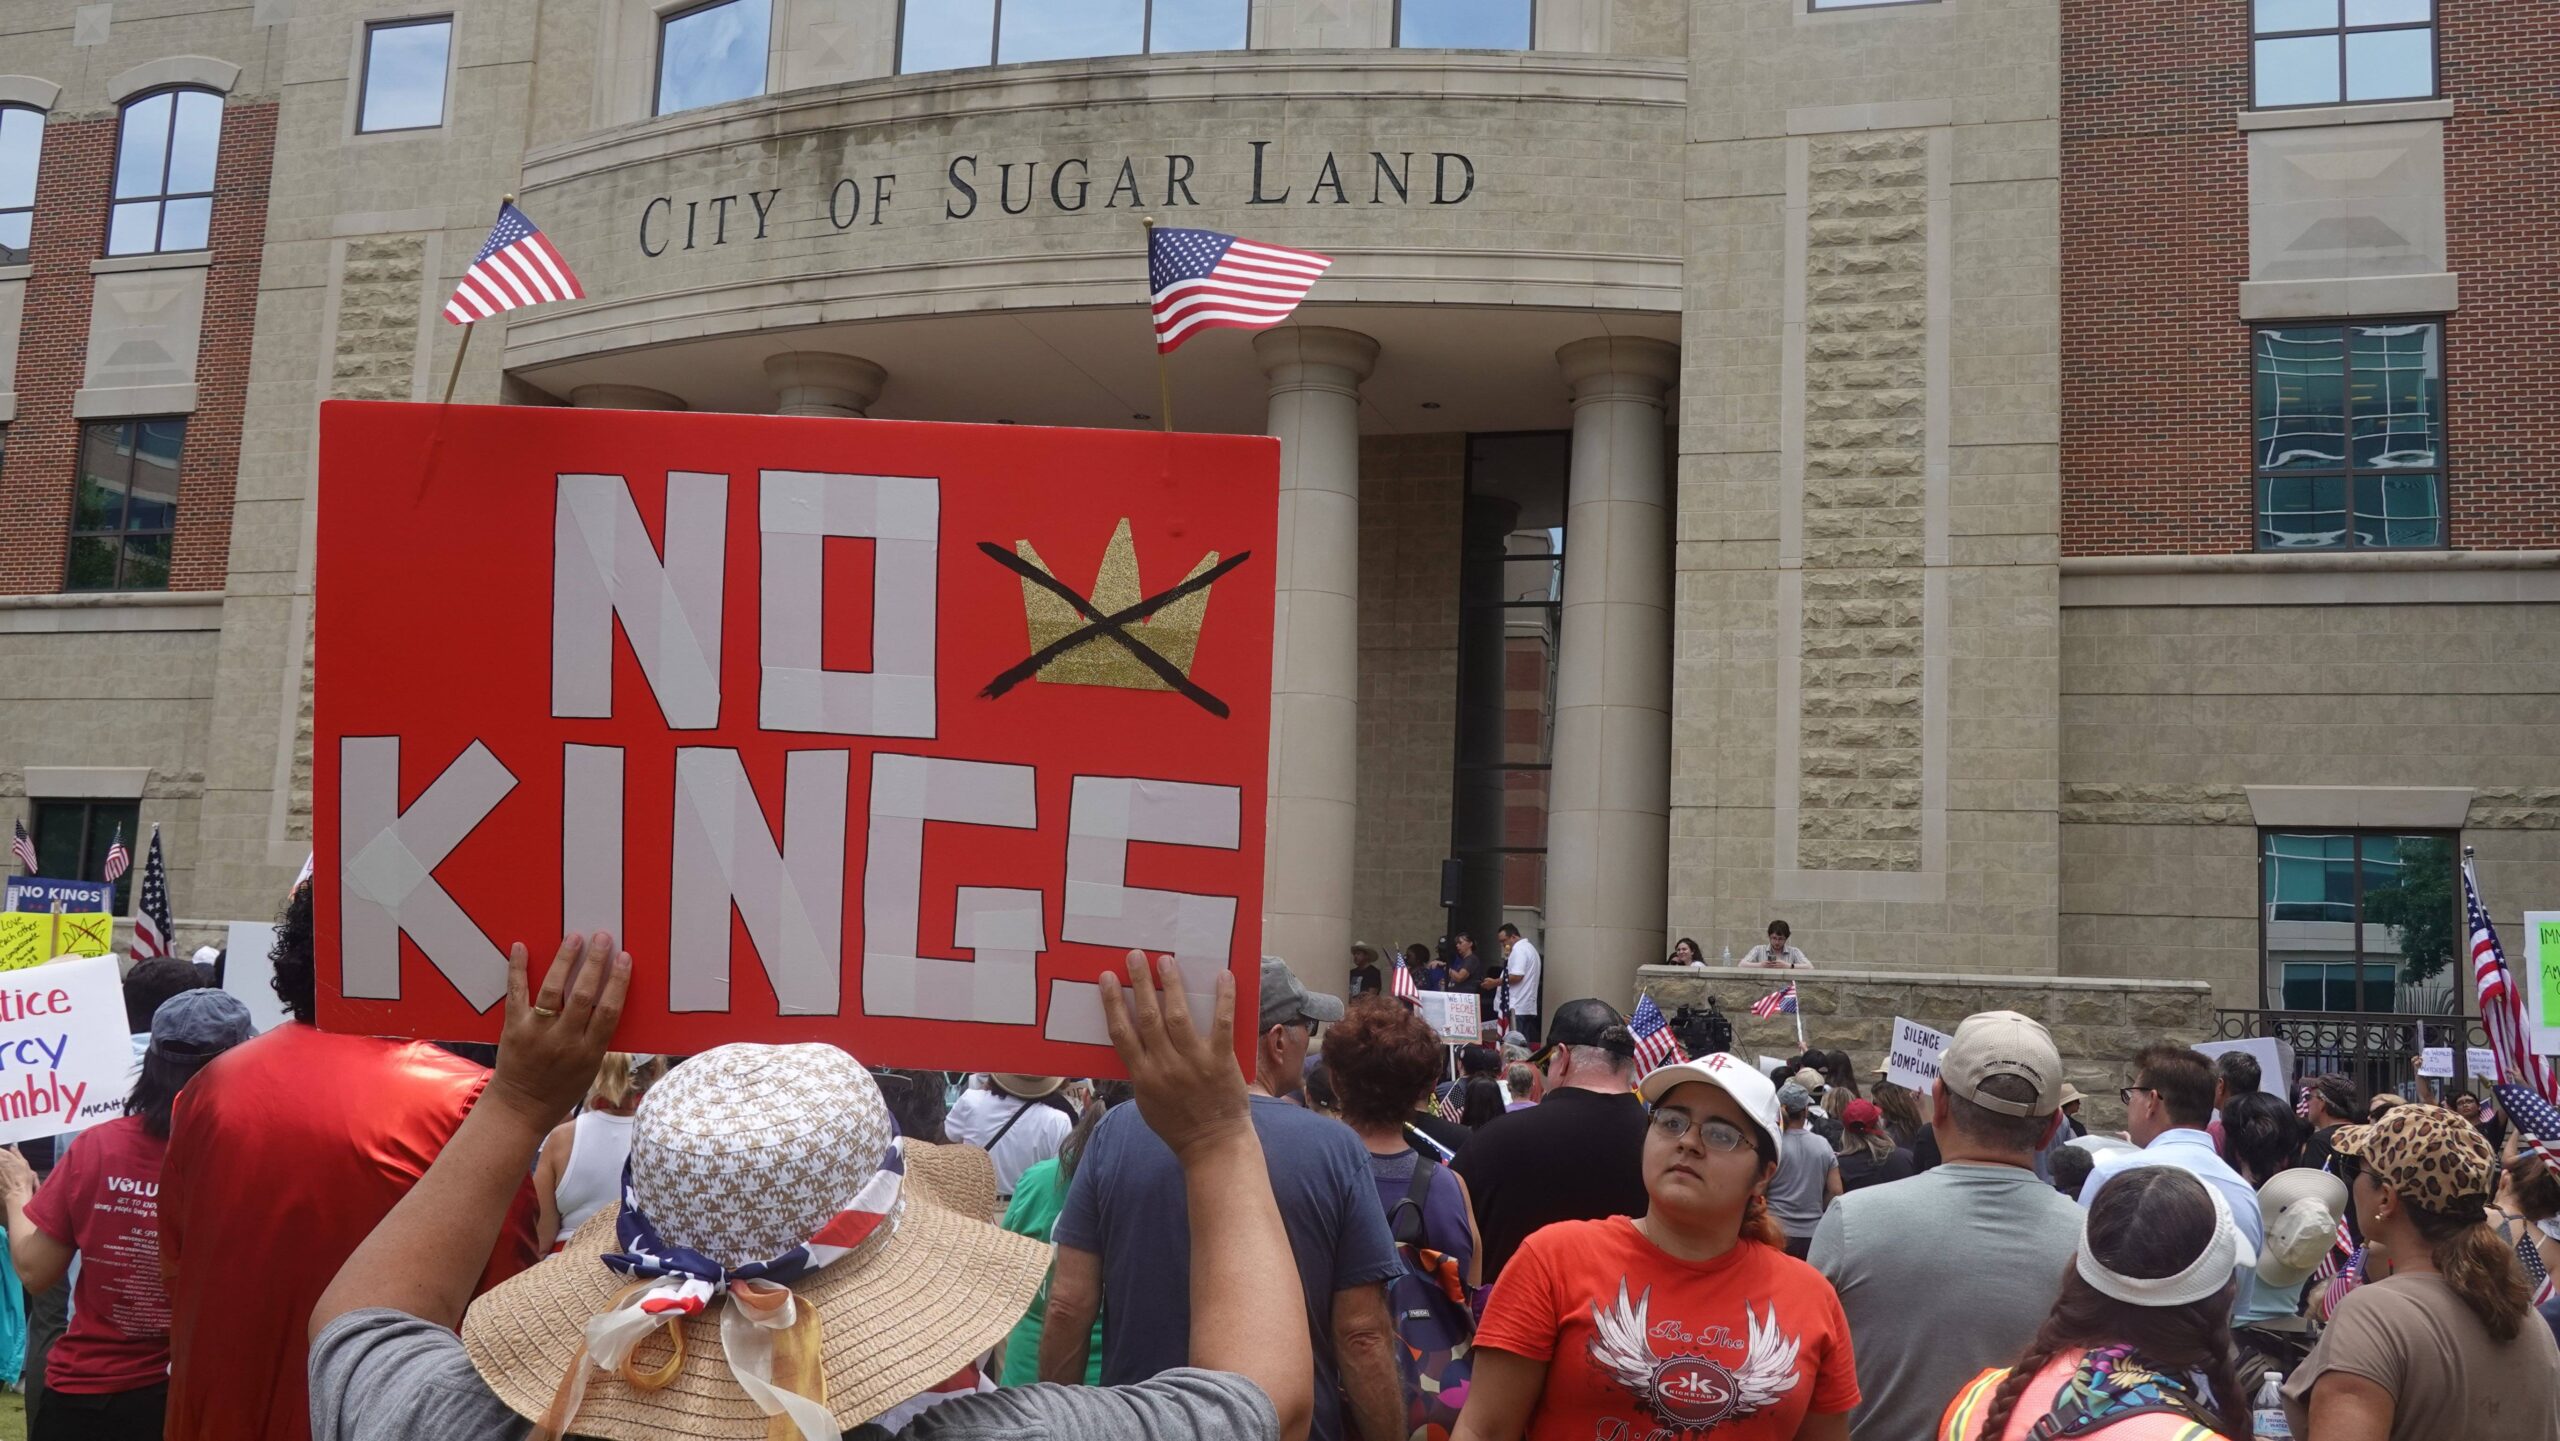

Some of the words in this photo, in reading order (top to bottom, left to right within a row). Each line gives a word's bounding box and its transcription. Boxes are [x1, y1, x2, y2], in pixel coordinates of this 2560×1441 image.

[639, 188, 782, 258] CITY
[828, 174, 896, 230] OF
[945, 154, 1200, 220] SUGAR
[1244, 140, 1475, 205] LAND
[550, 469, 940, 740] NO
[19, 885, 44, 898] NO
[48, 887, 101, 902] KINGS
[340, 735, 1242, 1046] KINGS
[0, 988, 72, 1022] tice
[1450, 1003, 1475, 1015] PEOPLE
[1903, 1025, 1941, 1050] SILENCE
[1917, 1048, 1923, 1058] IS
[0, 1071, 87, 1124] mbly
[80, 1098, 121, 1117] MICAH
[1649, 1320, 1693, 1342] Be
[1697, 1325, 1745, 1349] The
[1669, 1389, 1717, 1399] KICKSTART
